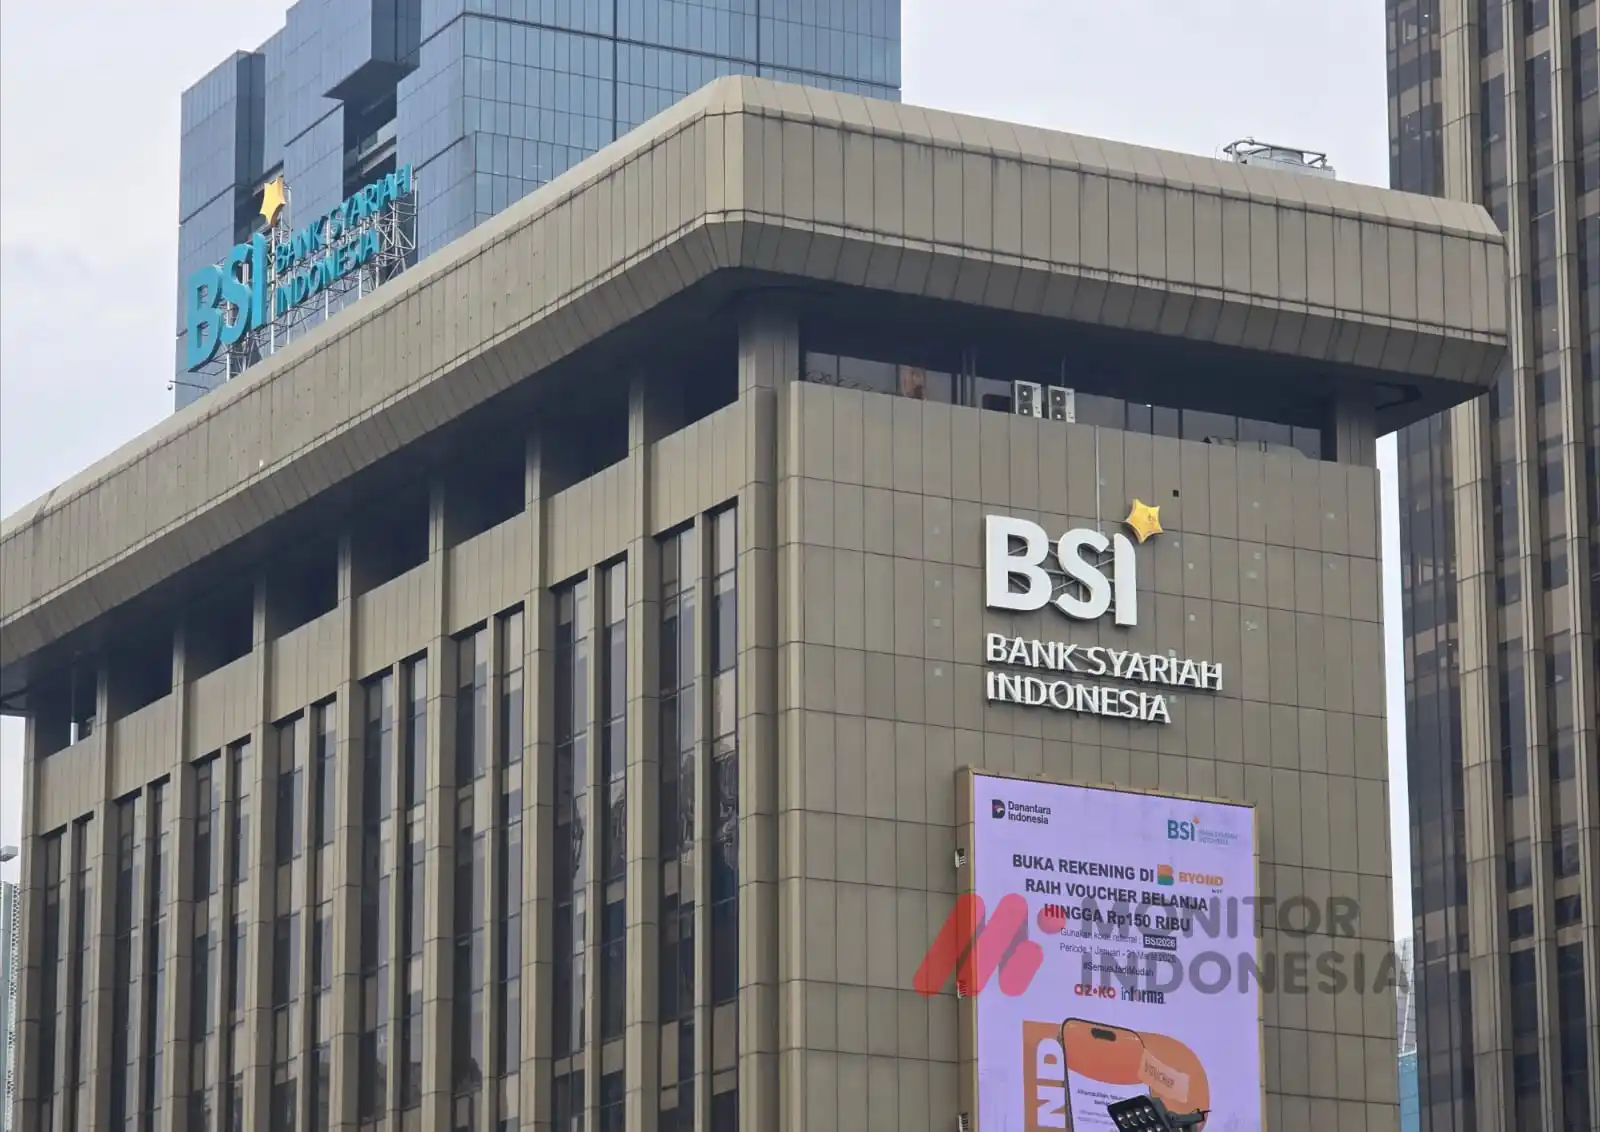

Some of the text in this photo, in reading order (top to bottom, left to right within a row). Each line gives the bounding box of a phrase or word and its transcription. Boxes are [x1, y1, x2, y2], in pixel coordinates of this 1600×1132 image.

[275, 163, 414, 273] BANK SYARIAH
[276, 229, 380, 317] INDONESIA
[187, 232, 268, 372] BSI
[986, 514, 1137, 626] BSI
[986, 633, 1223, 691] BANK SYARIAH
[986, 671, 1172, 724] INDONESIA
[1008, 800, 1051, 815] Danantara
[1008, 811, 1049, 825] Indonesia
[1167, 819, 1195, 842] BSI
[1012, 854, 1054, 872] BUKA
[1059, 859, 1136, 881] REKENING
[1140, 868, 1154, 883] DI
[1179, 871, 1224, 886] BYOND
[1025, 878, 1208, 912] RAIH VOUCHER BELANJA
[1044, 903, 1191, 932] HINGGA Rp150 RIBU
[1060, 927, 1092, 938] Gunakan
